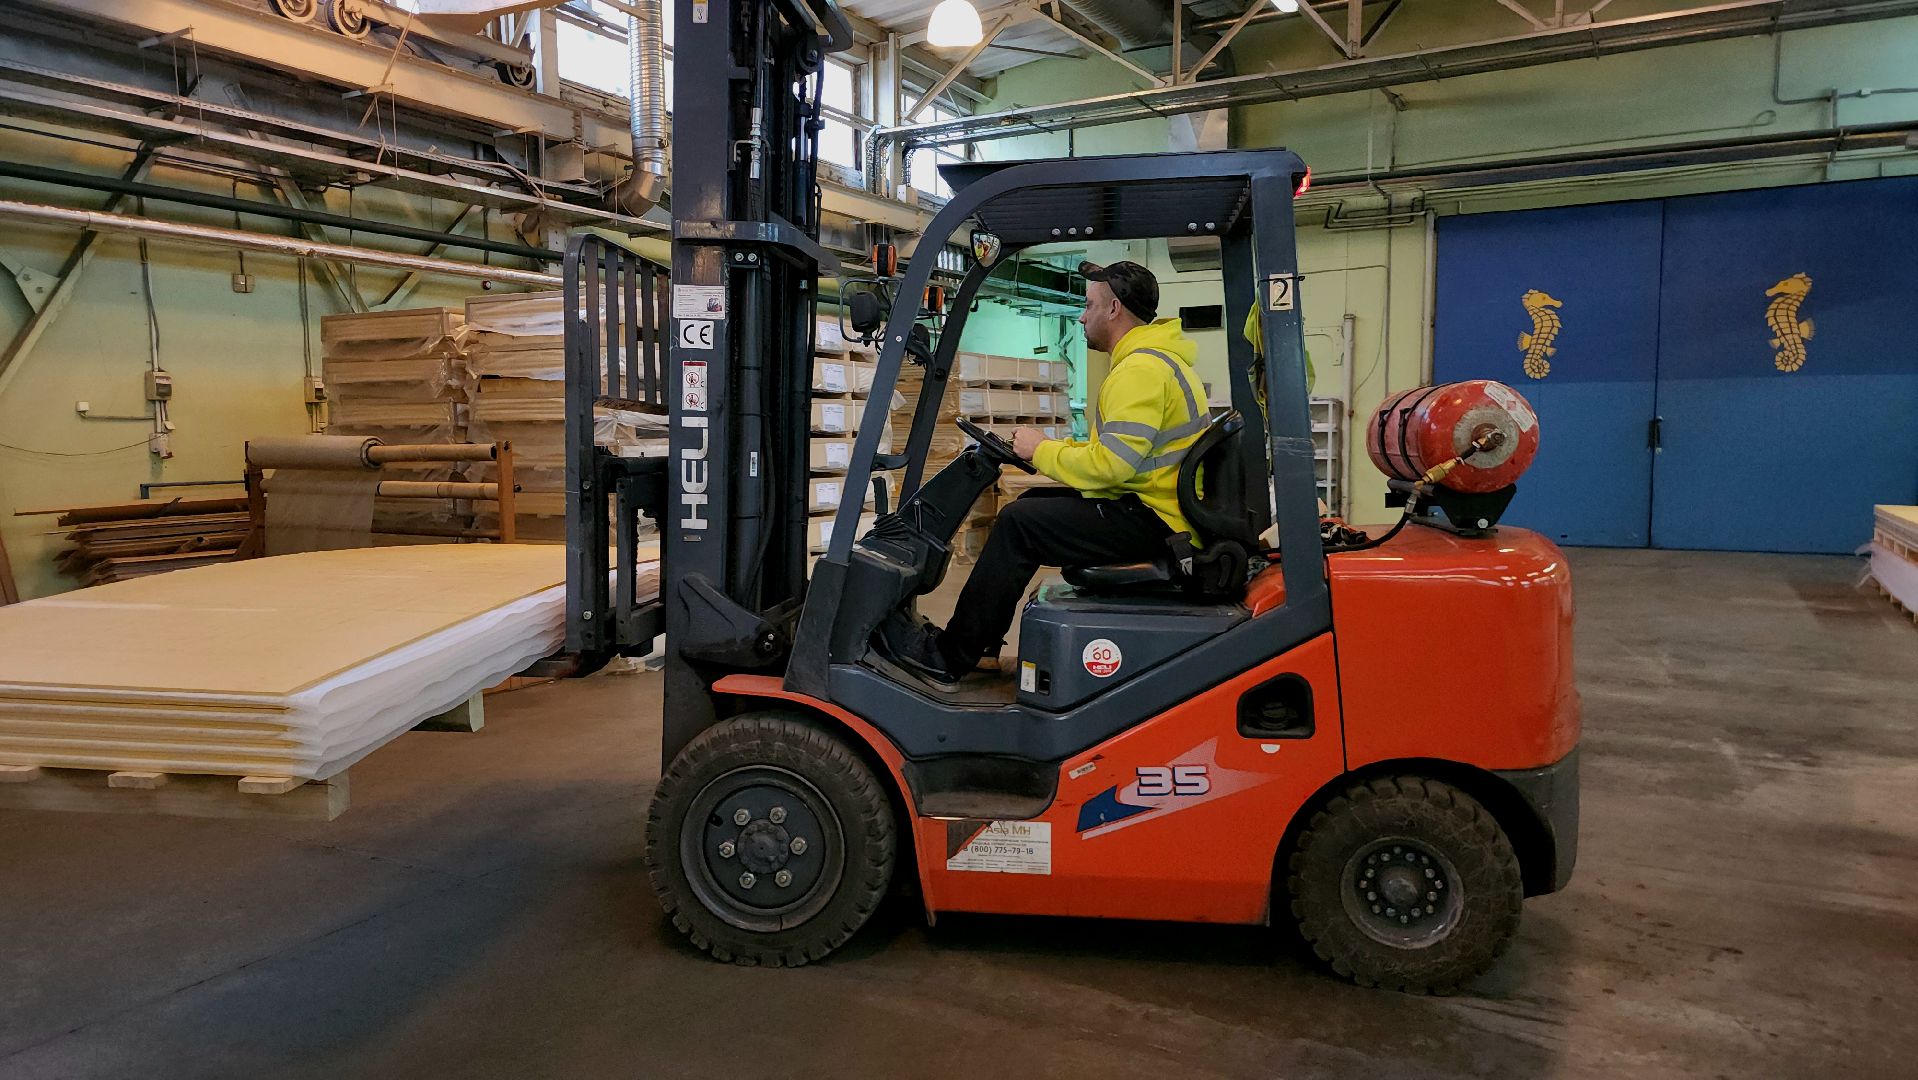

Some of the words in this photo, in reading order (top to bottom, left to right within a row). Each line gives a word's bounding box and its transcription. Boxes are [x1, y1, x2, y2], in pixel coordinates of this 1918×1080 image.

[1273, 279, 1290, 306] 2
[683, 324, 711, 345] CE
[681, 417, 708, 529] HELI
[1093, 647, 1111, 660] 60
[1136, 766, 1210, 796] 35
[1012, 825, 1031, 835] MH
[971, 845, 992, 855] (800)
